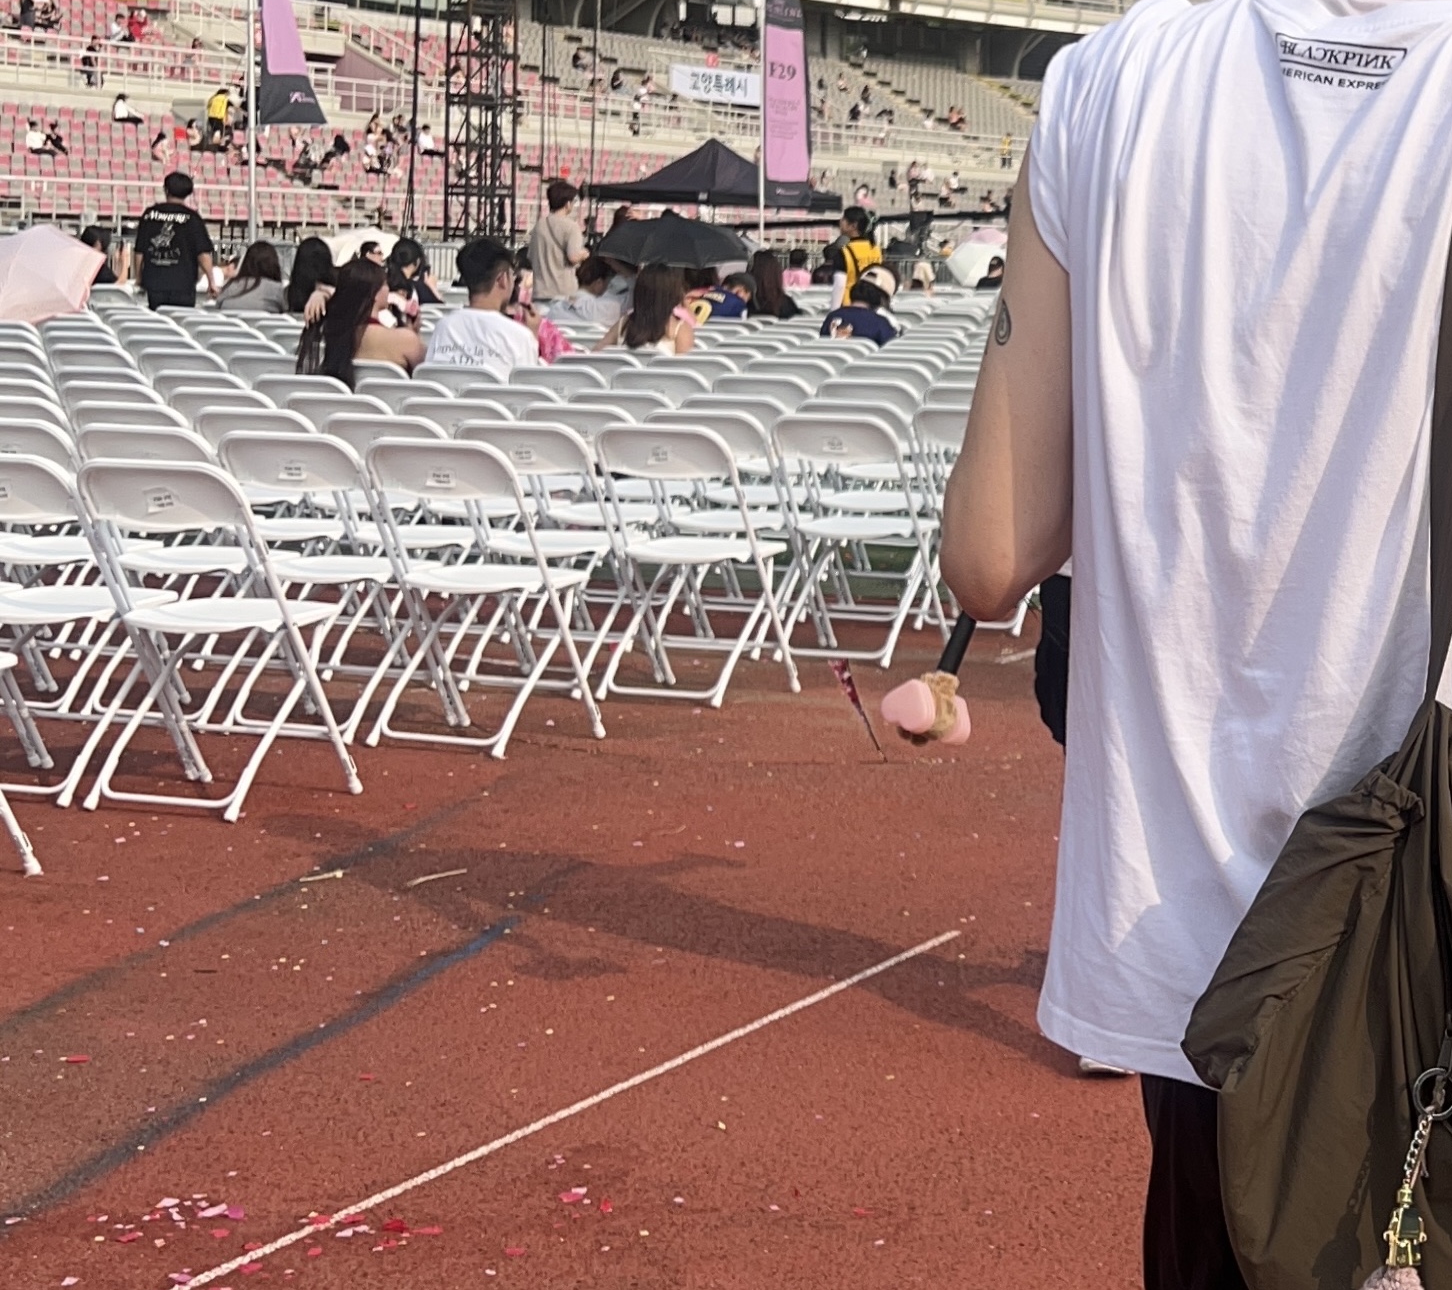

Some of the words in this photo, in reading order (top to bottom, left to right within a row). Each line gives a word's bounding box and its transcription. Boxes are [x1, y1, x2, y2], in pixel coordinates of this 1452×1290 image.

[689, 72, 748, 99] 고양특례시
[1282, 67, 1334, 86] ERICAN
[1338, 78, 1388, 91] EXPRE
